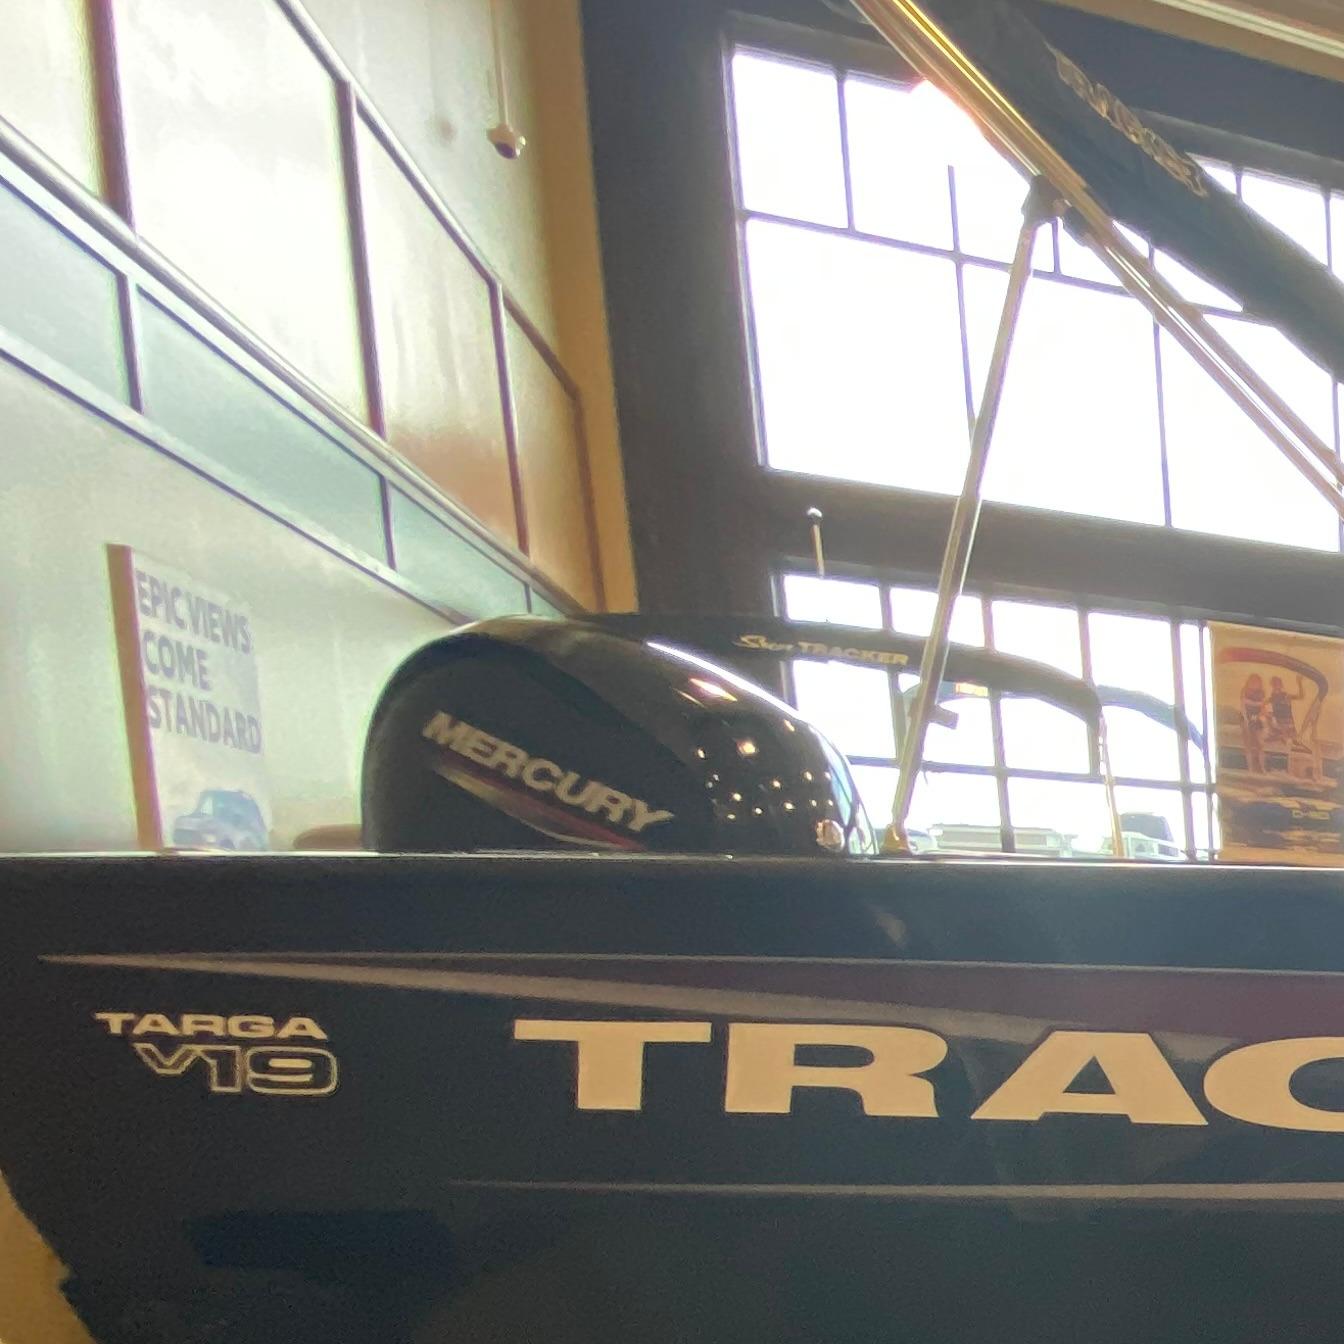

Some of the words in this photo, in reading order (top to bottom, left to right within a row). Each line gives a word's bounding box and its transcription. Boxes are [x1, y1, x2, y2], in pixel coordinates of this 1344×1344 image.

[136, 570, 187, 630] EPIC
[187, 592, 254, 655] VIEWS
[142, 630, 212, 692] COME
[147, 684, 263, 755] STANDARD
[422, 710, 675, 832] MERCURY
[94, 1011, 328, 1040] TARGA
[131, 1042, 339, 1096] V19
